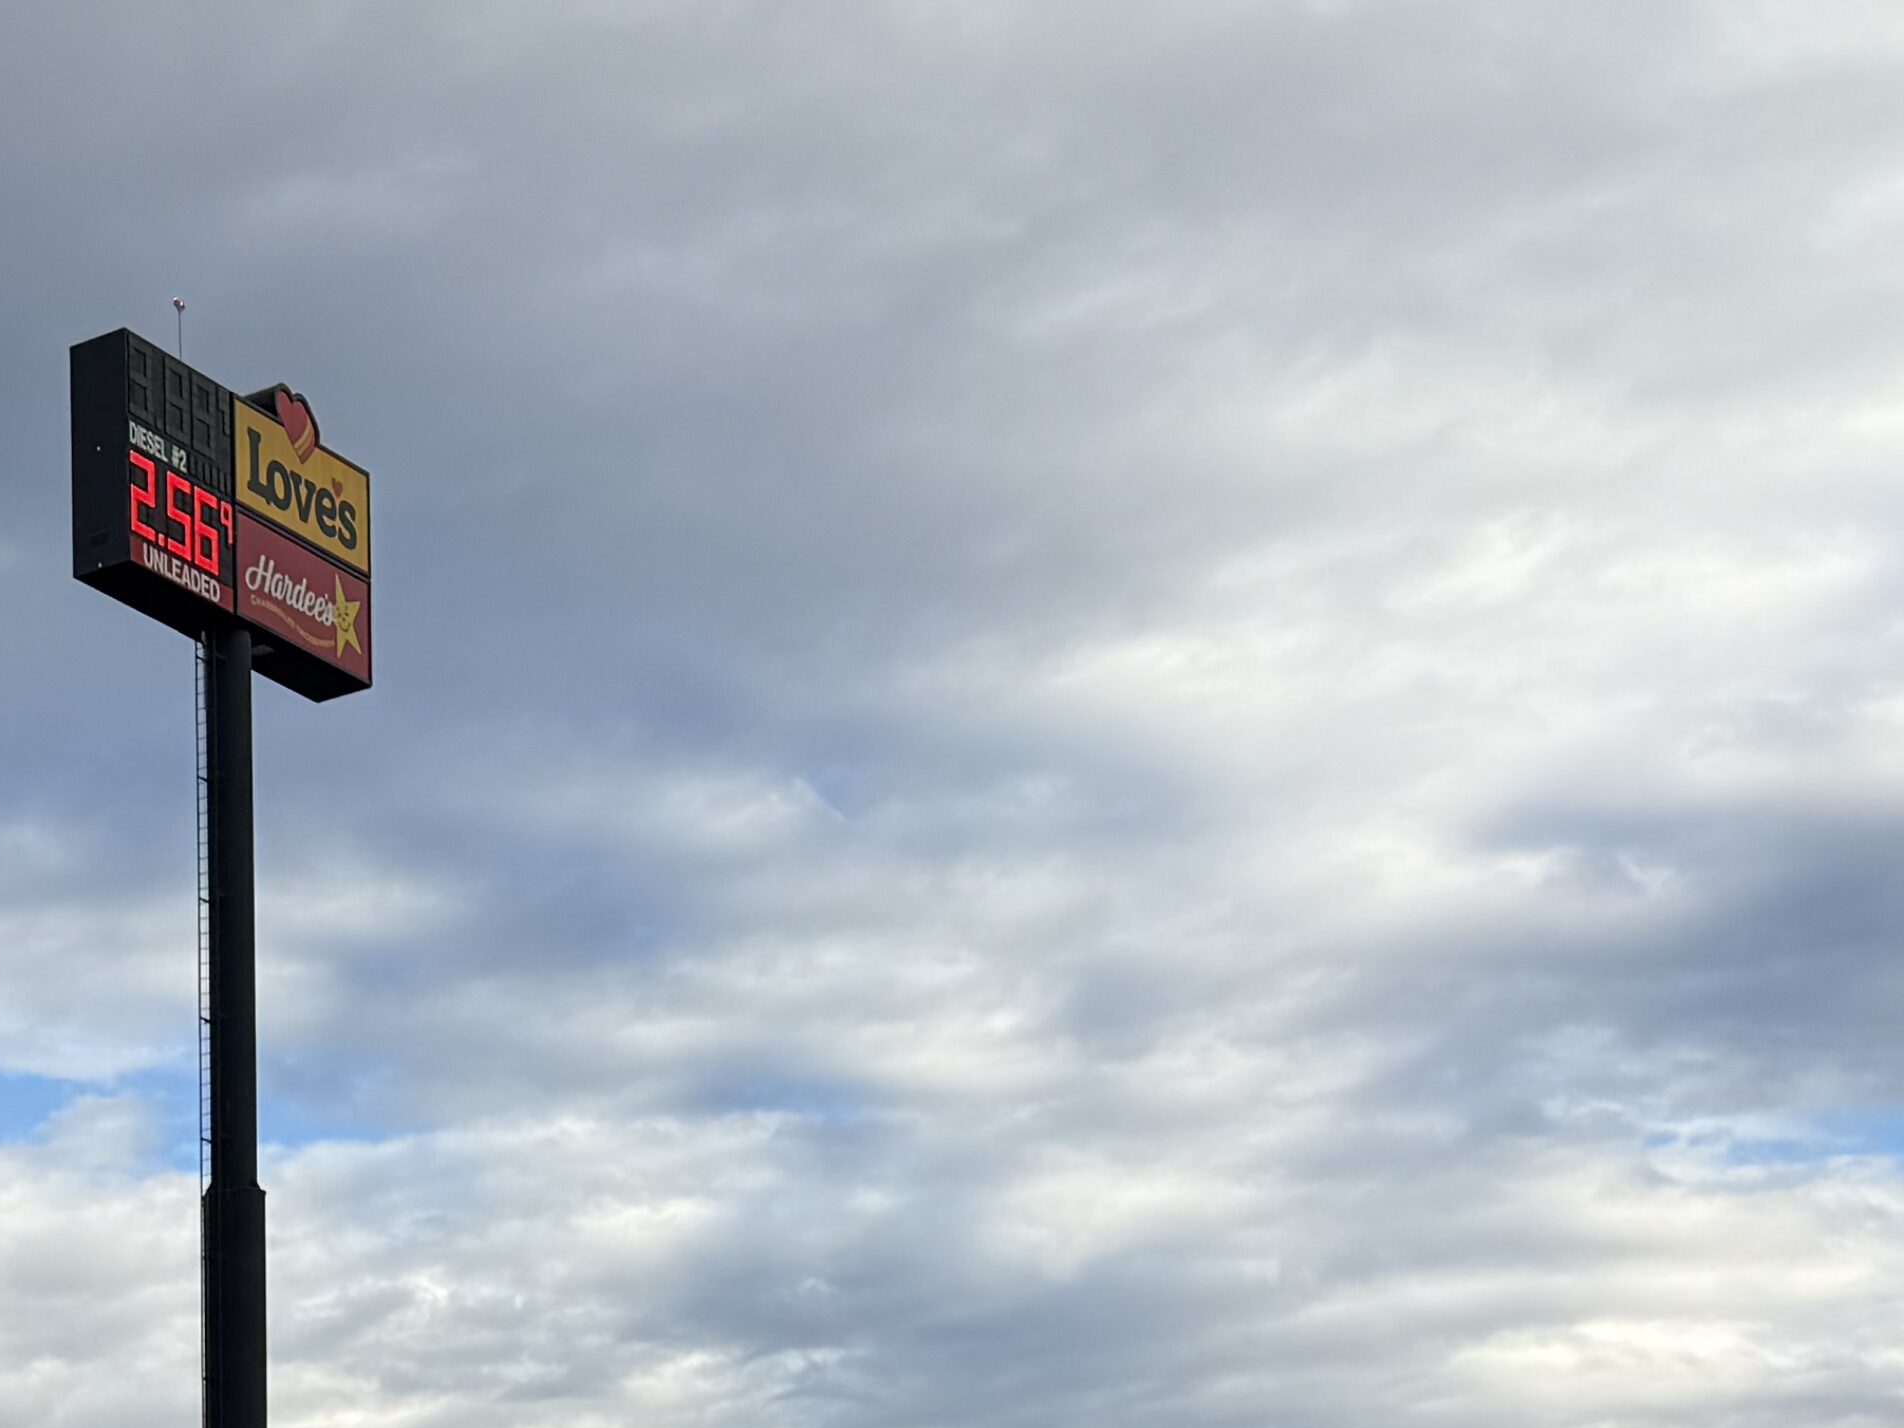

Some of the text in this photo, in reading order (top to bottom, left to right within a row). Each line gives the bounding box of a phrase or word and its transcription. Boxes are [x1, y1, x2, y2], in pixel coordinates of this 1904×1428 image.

[129, 420, 169, 463] DIESEL
[143, 542, 221, 603] UNLEADED
[245, 555, 337, 627] Hardee's
